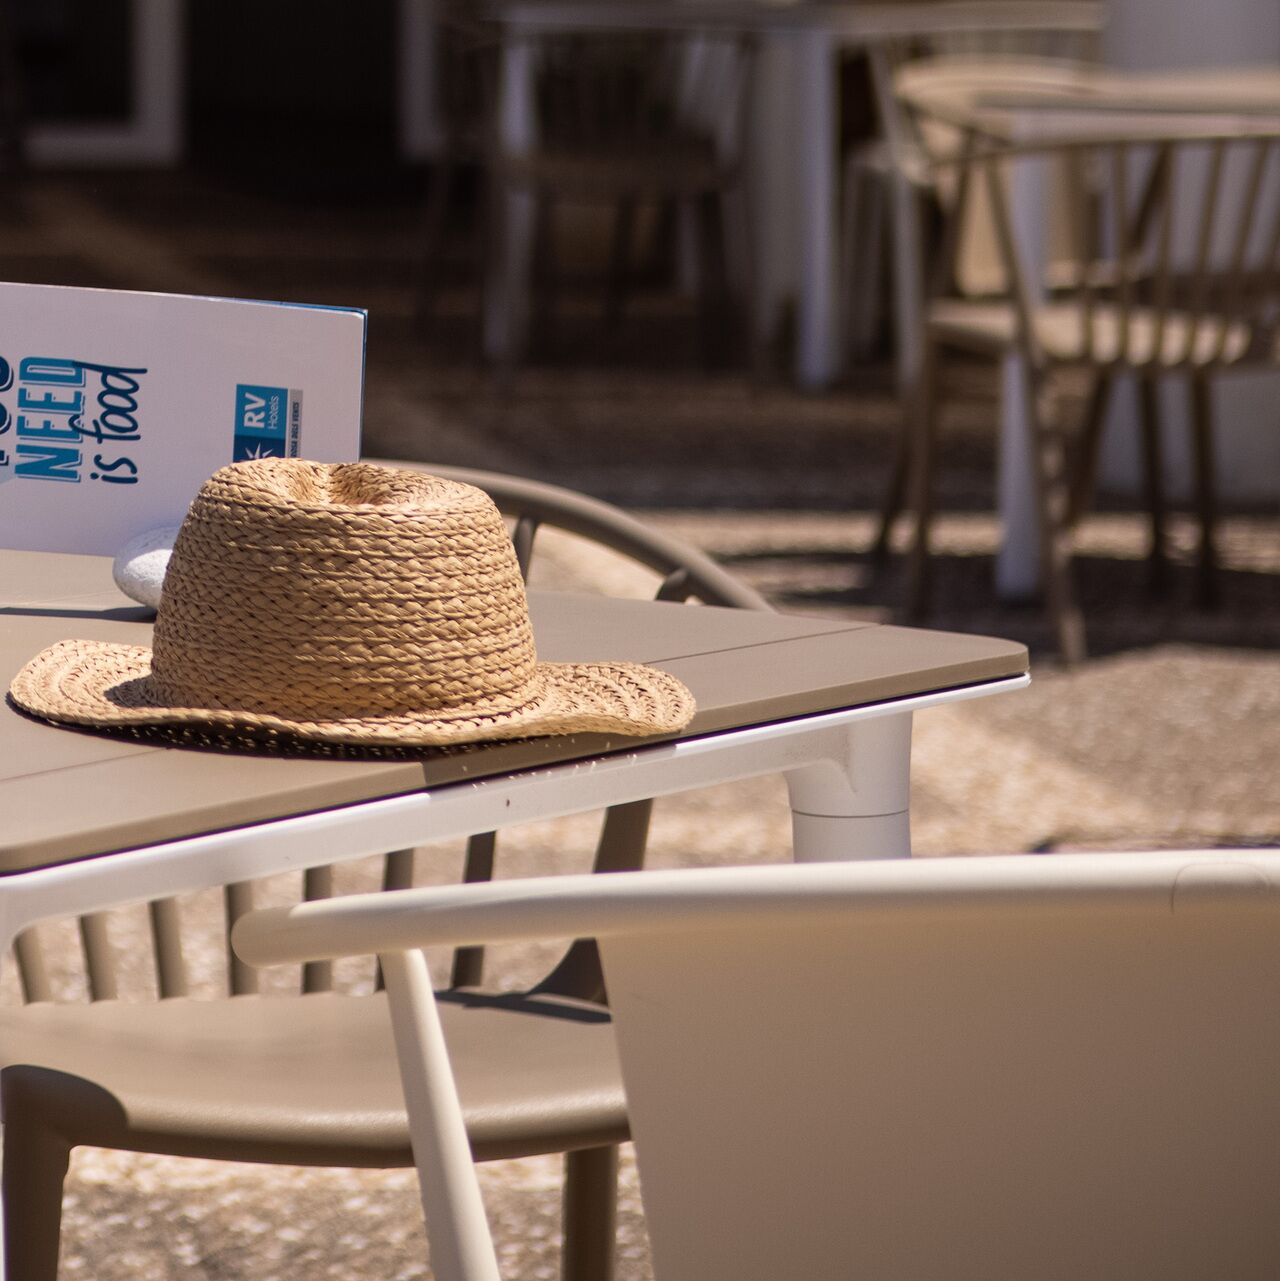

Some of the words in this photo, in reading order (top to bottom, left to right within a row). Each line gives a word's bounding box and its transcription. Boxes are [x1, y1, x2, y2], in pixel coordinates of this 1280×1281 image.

[15, 356, 85, 483] NEED
[68, 360, 148, 444] food
[244, 392, 266, 428] RV
[267, 395, 280, 430] Hotels
[90, 454, 138, 484] is
